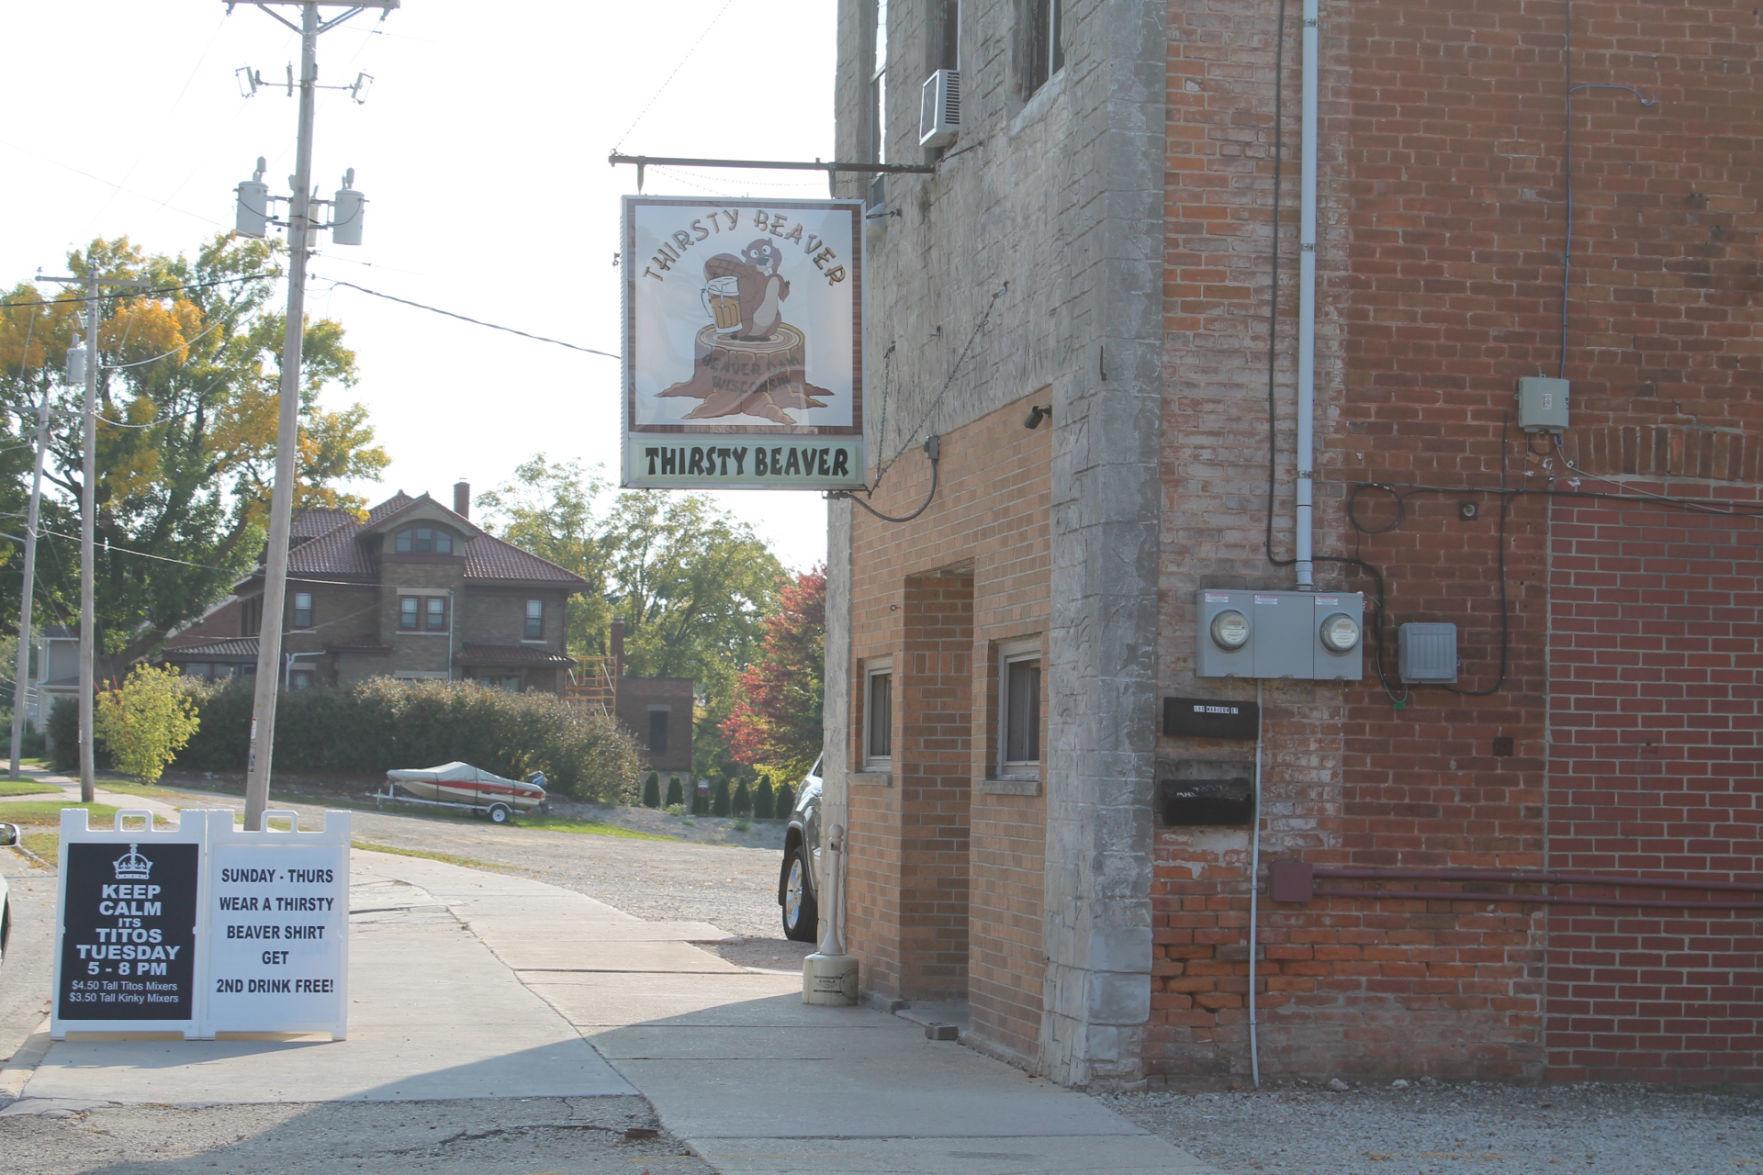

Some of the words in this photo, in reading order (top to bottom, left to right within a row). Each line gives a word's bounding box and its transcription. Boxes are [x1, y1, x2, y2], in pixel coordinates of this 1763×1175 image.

[643, 208, 739, 282] THIRSTY
[753, 208, 846, 287] BEAVER
[645, 446, 748, 476] THIRSTY
[754, 446, 849, 477] BEAVER
[221, 868, 276, 883] SUNDAY
[288, 869, 334, 883] THURS
[102, 884, 161, 899] KEEP
[99, 901, 162, 916] CALM
[219, 897, 259, 911] WEAR
[262, 897, 272, 911] A
[276, 897, 335, 912] THIRSTY
[118, 918, 142, 928] ITS
[96, 928, 162, 943] TITOS
[227, 925, 280, 939] BEAVER
[284, 925, 326, 940] SHIRT
[76, 944, 180, 960] TUESDAY
[262, 951, 289, 965] GET
[87, 961, 100, 975] 5
[118, 962, 130, 975] 8
[137, 962, 167, 976] PM
[71, 980, 100, 990] $4.50
[102, 981, 118, 990] Tall
[120, 981, 144, 991] Titos
[146, 981, 178, 991] Mixers
[216, 979, 244, 993] 2ND
[248, 979, 291, 993] DRINK
[295, 979, 334, 993] FREE!
[69, 992, 97, 1002] $3.50
[99, 993, 116, 1002] Tall
[118, 993, 145, 1004] Kinky
[147, 993, 179, 1003] Mixers
